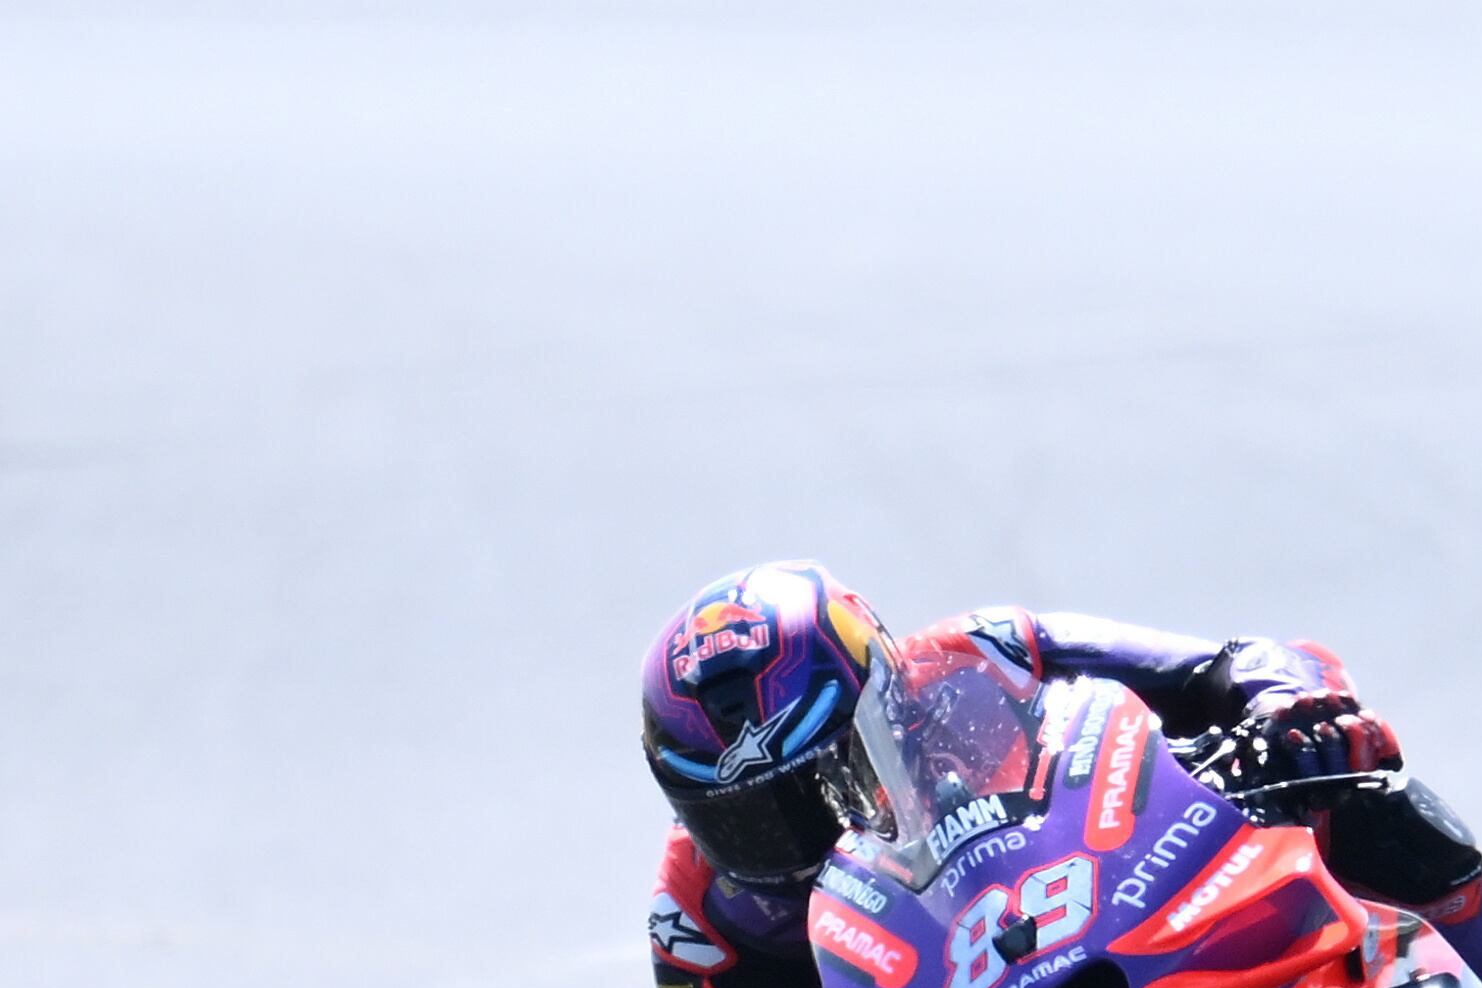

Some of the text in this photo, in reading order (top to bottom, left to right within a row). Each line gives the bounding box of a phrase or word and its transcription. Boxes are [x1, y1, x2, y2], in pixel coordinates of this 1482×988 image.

[1098, 713, 1144, 830] PRAMAC
[926, 794, 1007, 866] FIAMM
[939, 830, 1028, 898] prima
[1111, 800, 1219, 910] prima
[1168, 841, 1266, 932] MOTUL
[815, 911, 902, 975] PRAMAC
